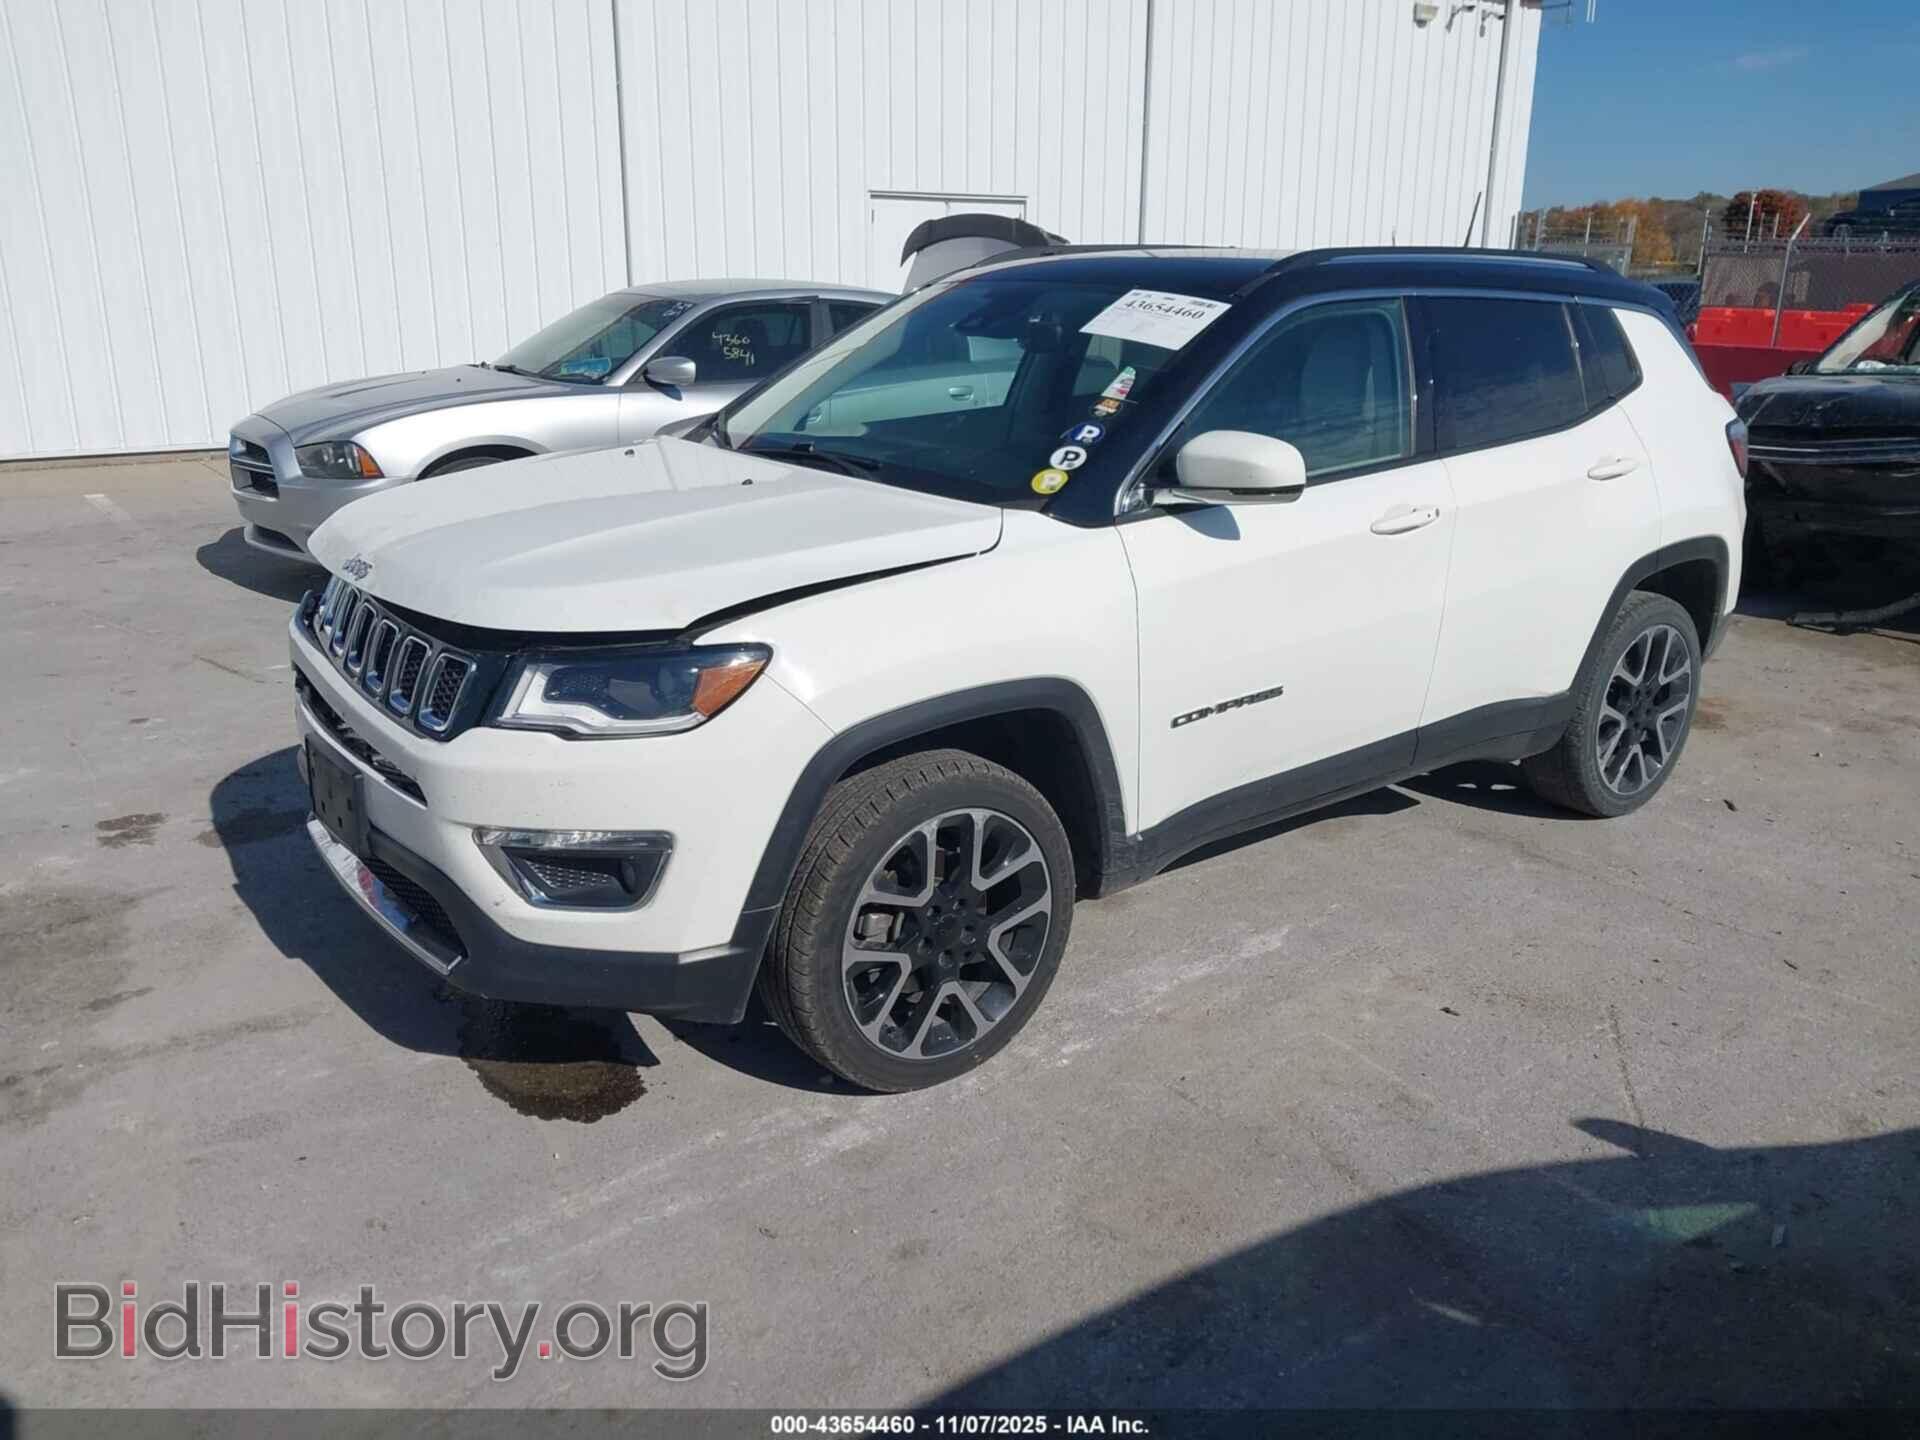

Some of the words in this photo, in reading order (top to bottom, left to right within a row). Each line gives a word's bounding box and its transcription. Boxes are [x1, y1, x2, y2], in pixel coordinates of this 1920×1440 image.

[1125, 299, 1206, 319] 43654460
[711, 330, 751, 346] 4360
[723, 346, 755, 367] 5841
[1171, 686, 1284, 728] COMPASS
